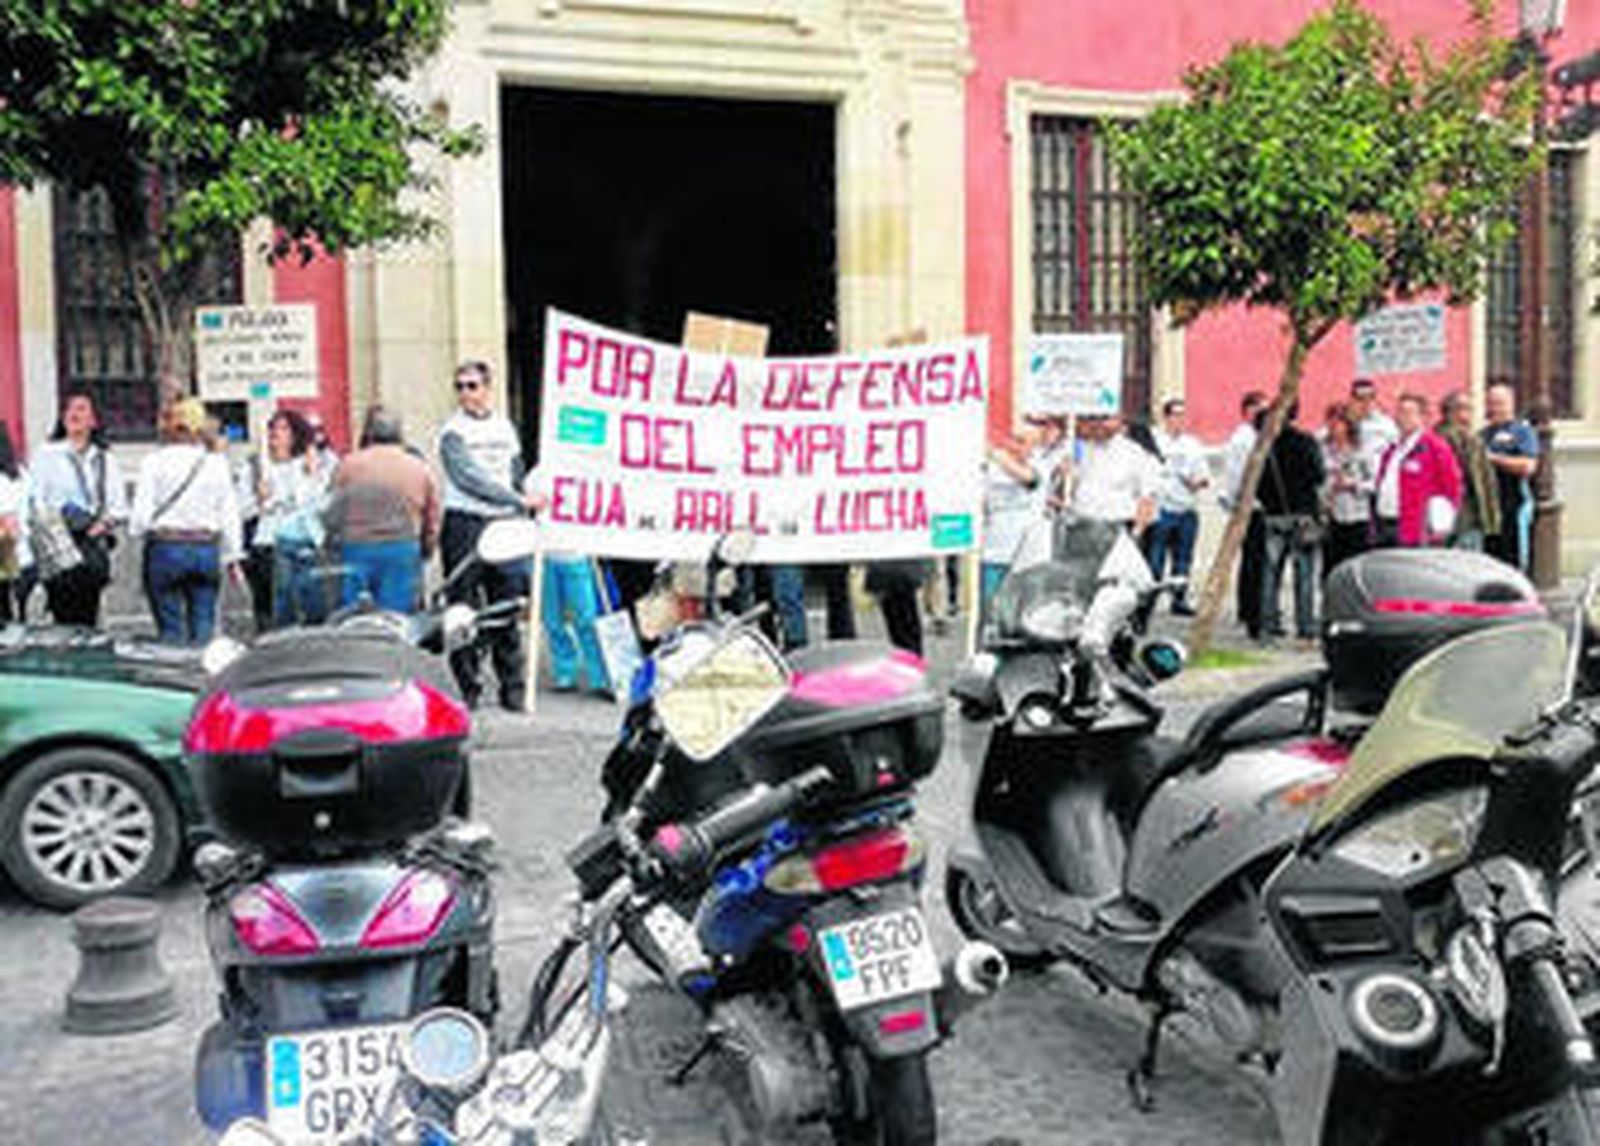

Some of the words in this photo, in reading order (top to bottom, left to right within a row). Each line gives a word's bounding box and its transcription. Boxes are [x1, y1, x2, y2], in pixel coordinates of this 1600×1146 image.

[557, 329, 654, 402] POR
[674, 352, 738, 408] LA
[762, 346, 986, 411] DEFENSA
[619, 413, 717, 474] DEL
[742, 419, 926, 477] EMPLEO
[813, 488, 929, 535] LUCHA
